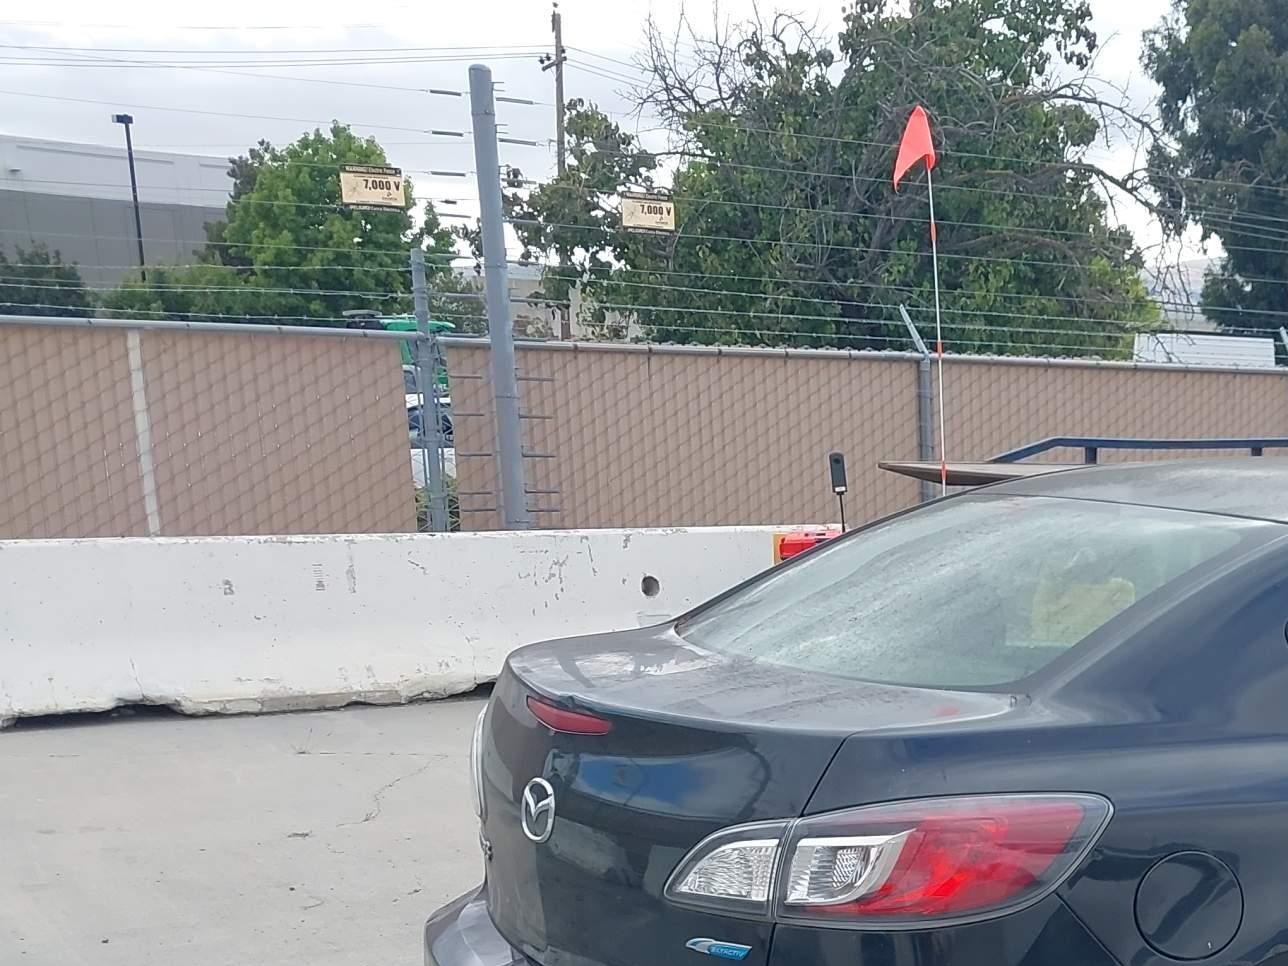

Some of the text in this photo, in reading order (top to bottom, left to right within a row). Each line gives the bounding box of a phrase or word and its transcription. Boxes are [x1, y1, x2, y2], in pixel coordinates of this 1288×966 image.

[363, 179, 400, 191] 7,000 V
[640, 204, 672, 217] 7,000 V
